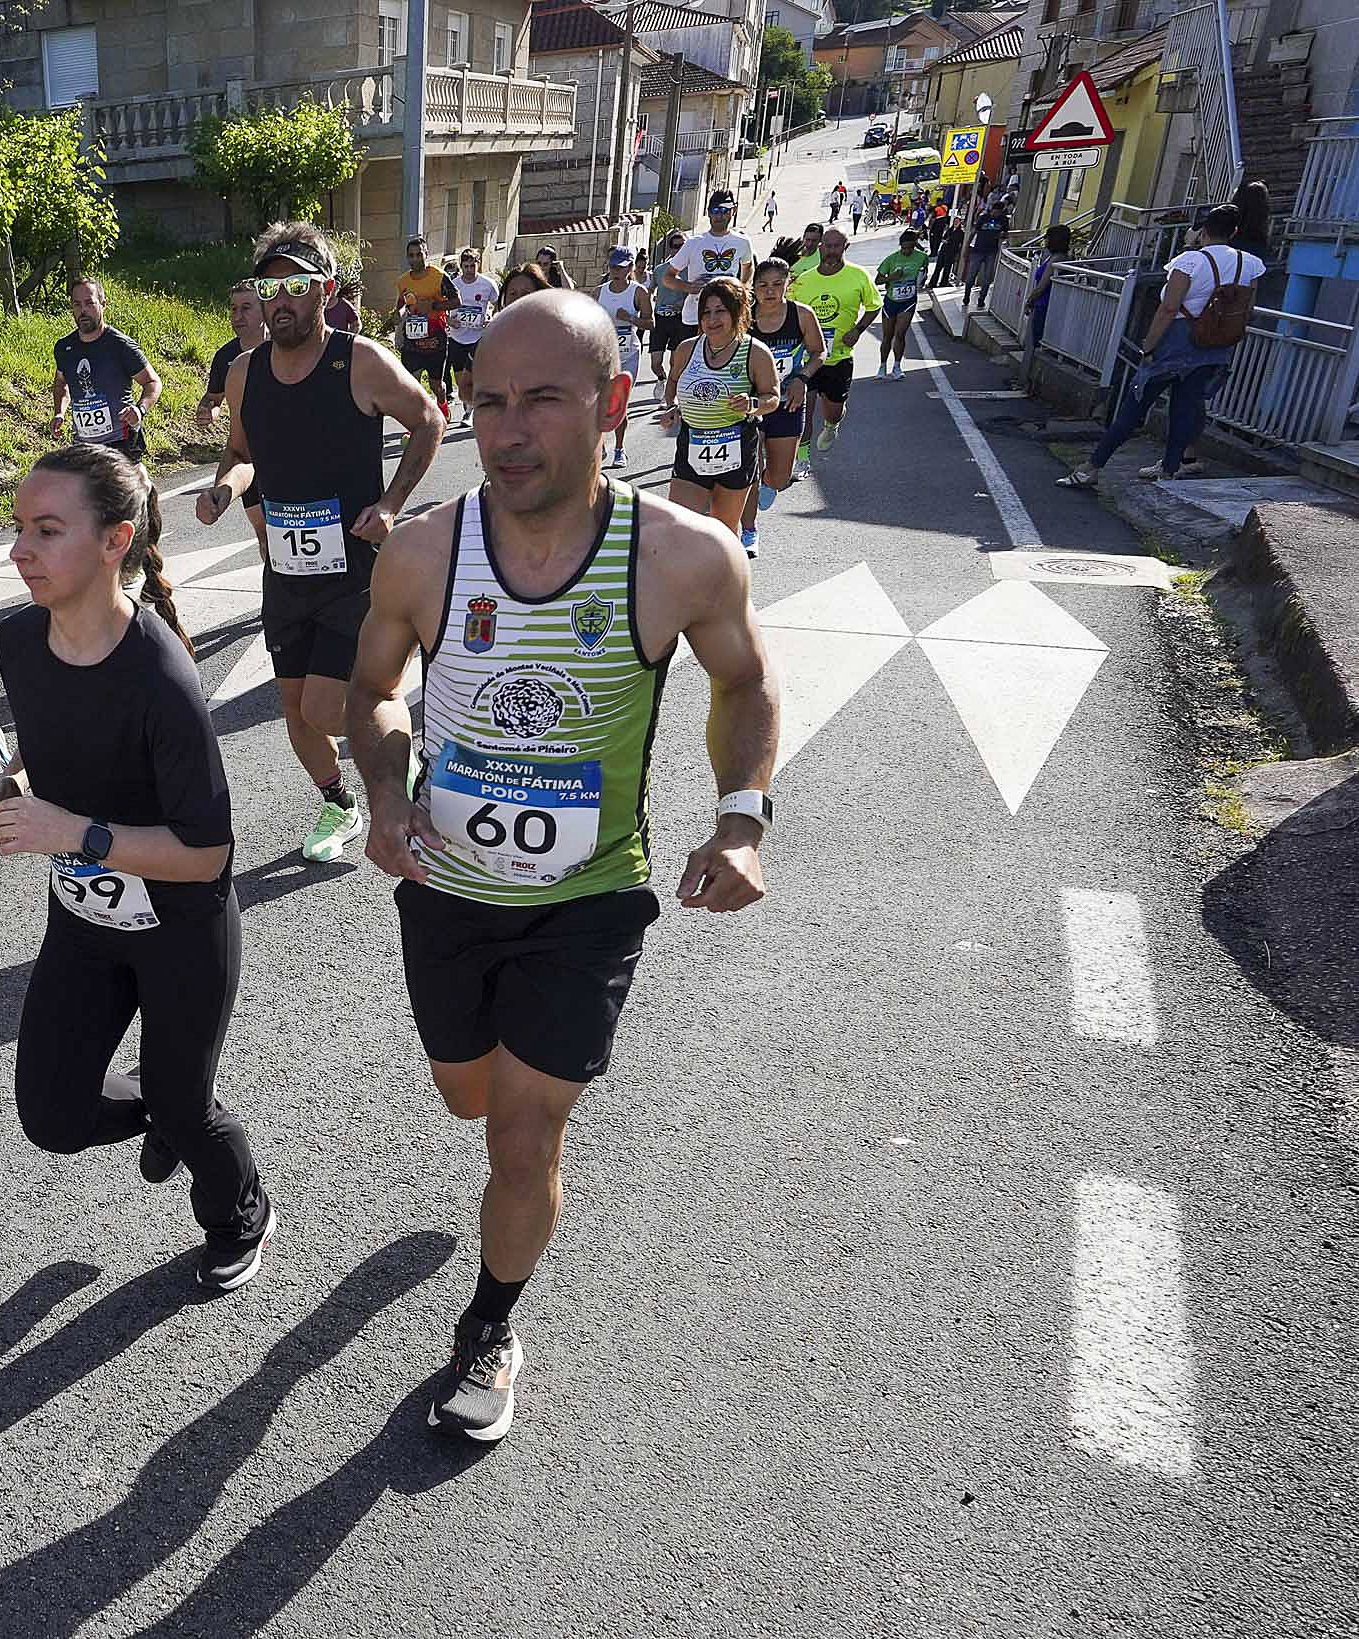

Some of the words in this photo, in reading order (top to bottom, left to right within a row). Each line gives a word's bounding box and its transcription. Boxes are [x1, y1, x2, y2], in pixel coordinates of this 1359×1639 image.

[461, 314, 478, 322] 217
[408, 323, 424, 333] 171
[76, 410, 106, 428] 128
[698, 444, 730, 463] 44
[283, 519, 306, 527] POIO
[282, 529, 322, 557] 15
[476, 740, 522, 753] Santomé
[523, 744, 537, 753] de
[537, 744, 577, 754] Piñeiro
[446, 760, 505, 785] MARATÓN
[506, 777, 519, 785] DE
[520, 774, 584, 790] FÁTIMA
[485, 759, 534, 775] XXXVII
[480, 784, 529, 801] POIO
[558, 792, 577, 800] 7.5
[580, 791, 600, 800] KM
[465, 802, 557, 855] 60
[511, 860, 537, 870] FROIZ
[57, 875, 126, 909] 99
